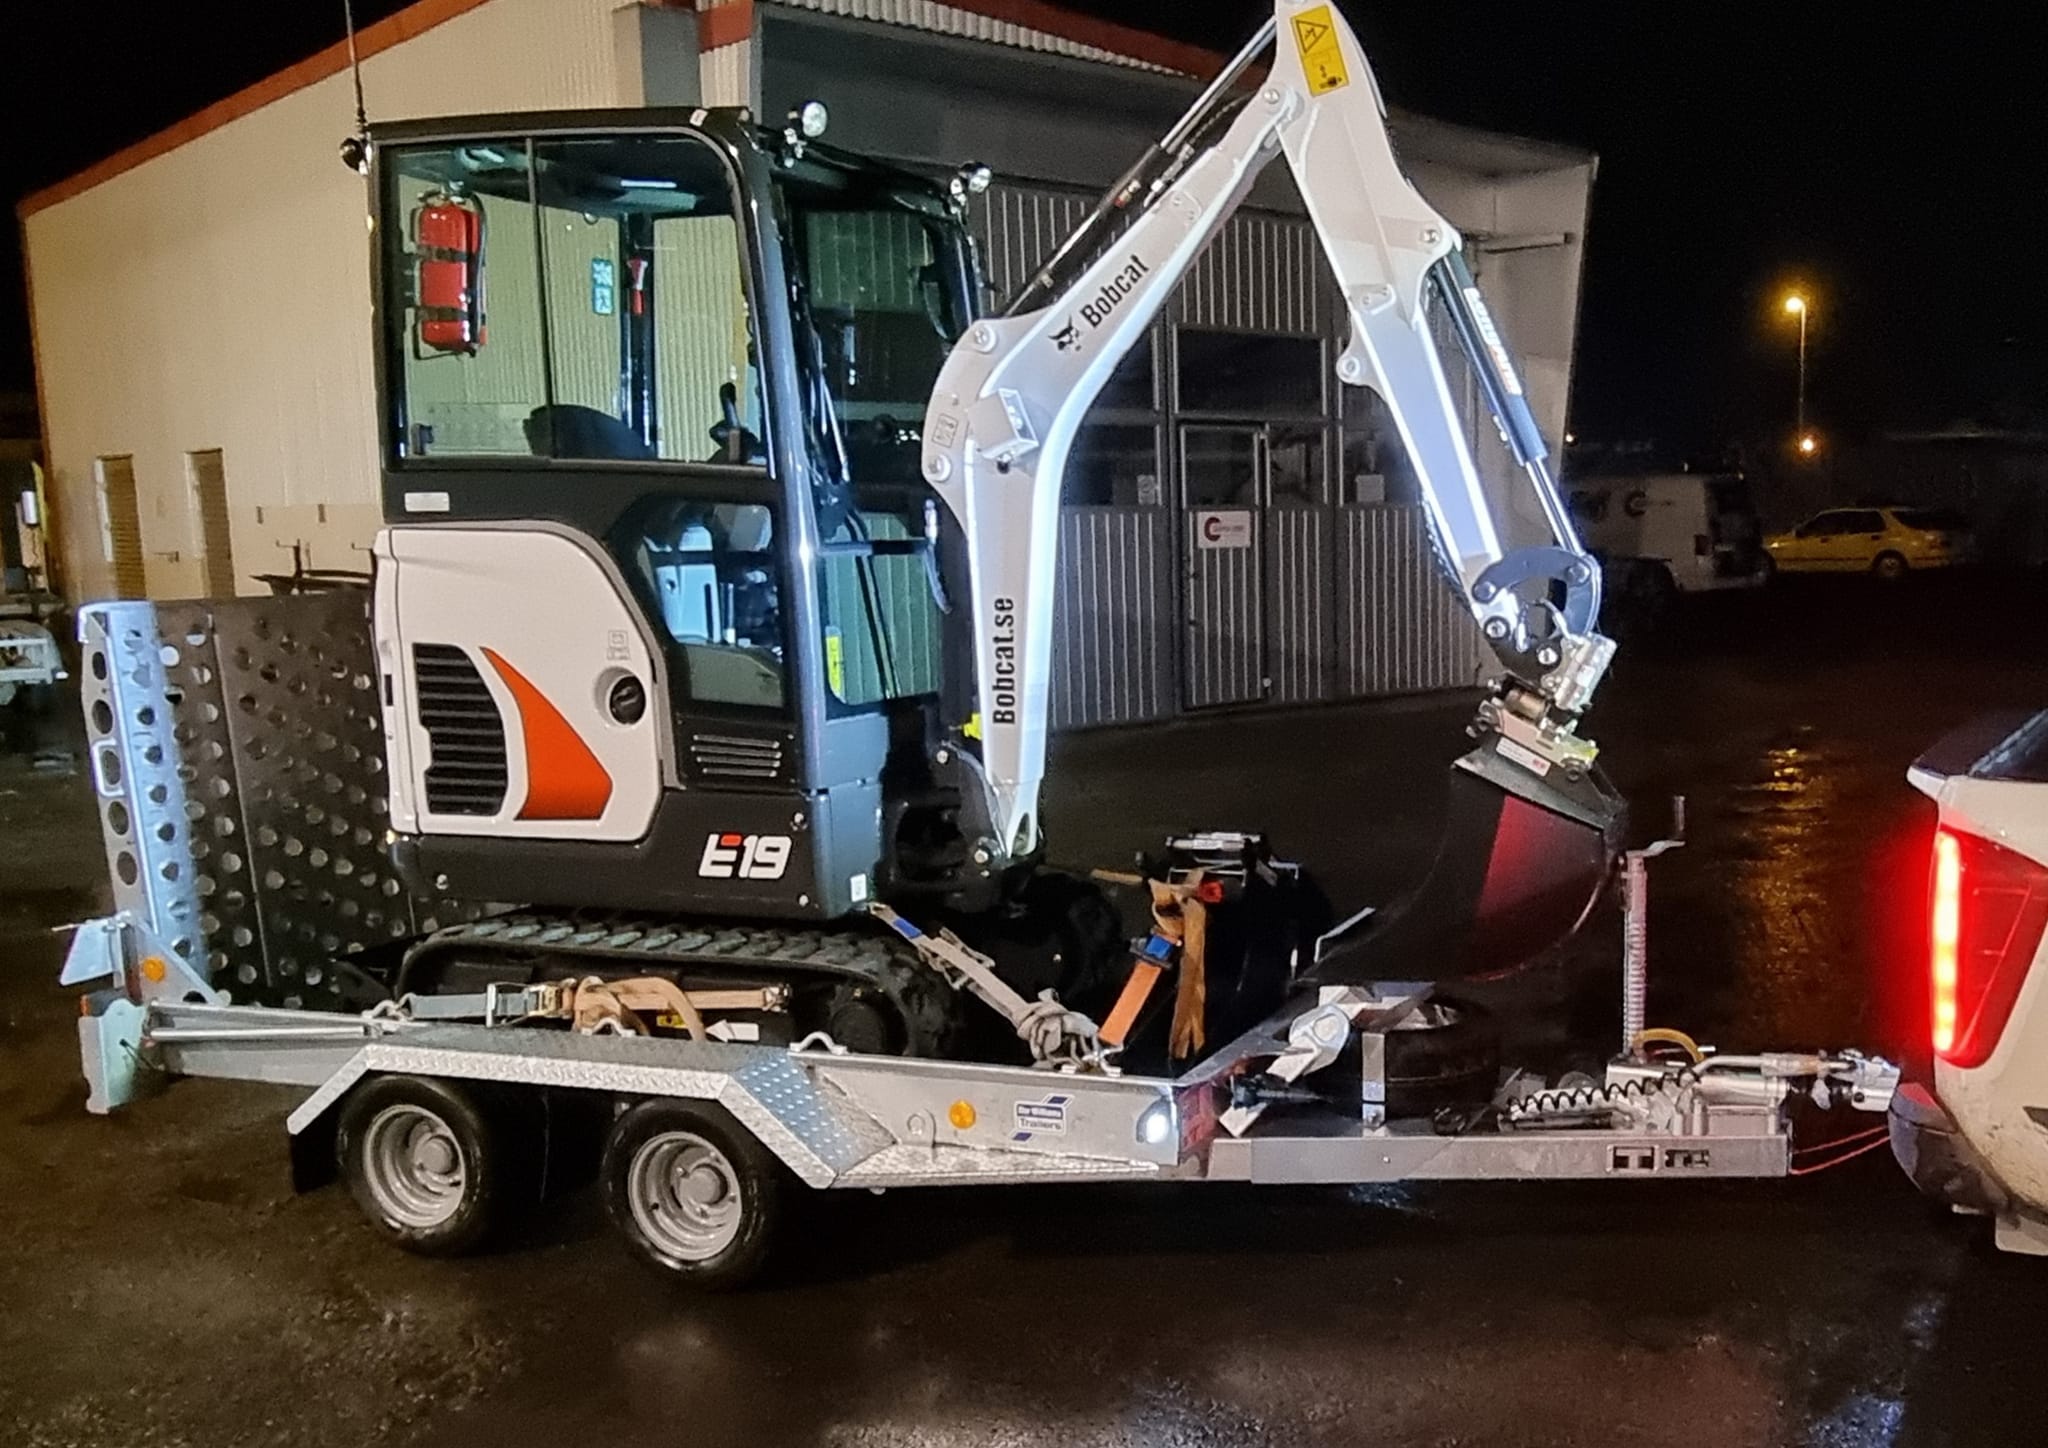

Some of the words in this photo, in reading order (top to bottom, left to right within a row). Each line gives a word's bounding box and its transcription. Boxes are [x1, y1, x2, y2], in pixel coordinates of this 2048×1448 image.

[1080, 254, 1150, 329] Bobcat
[992, 597, 1016, 724] Bobcat.se
[698, 833, 792, 879] E19
